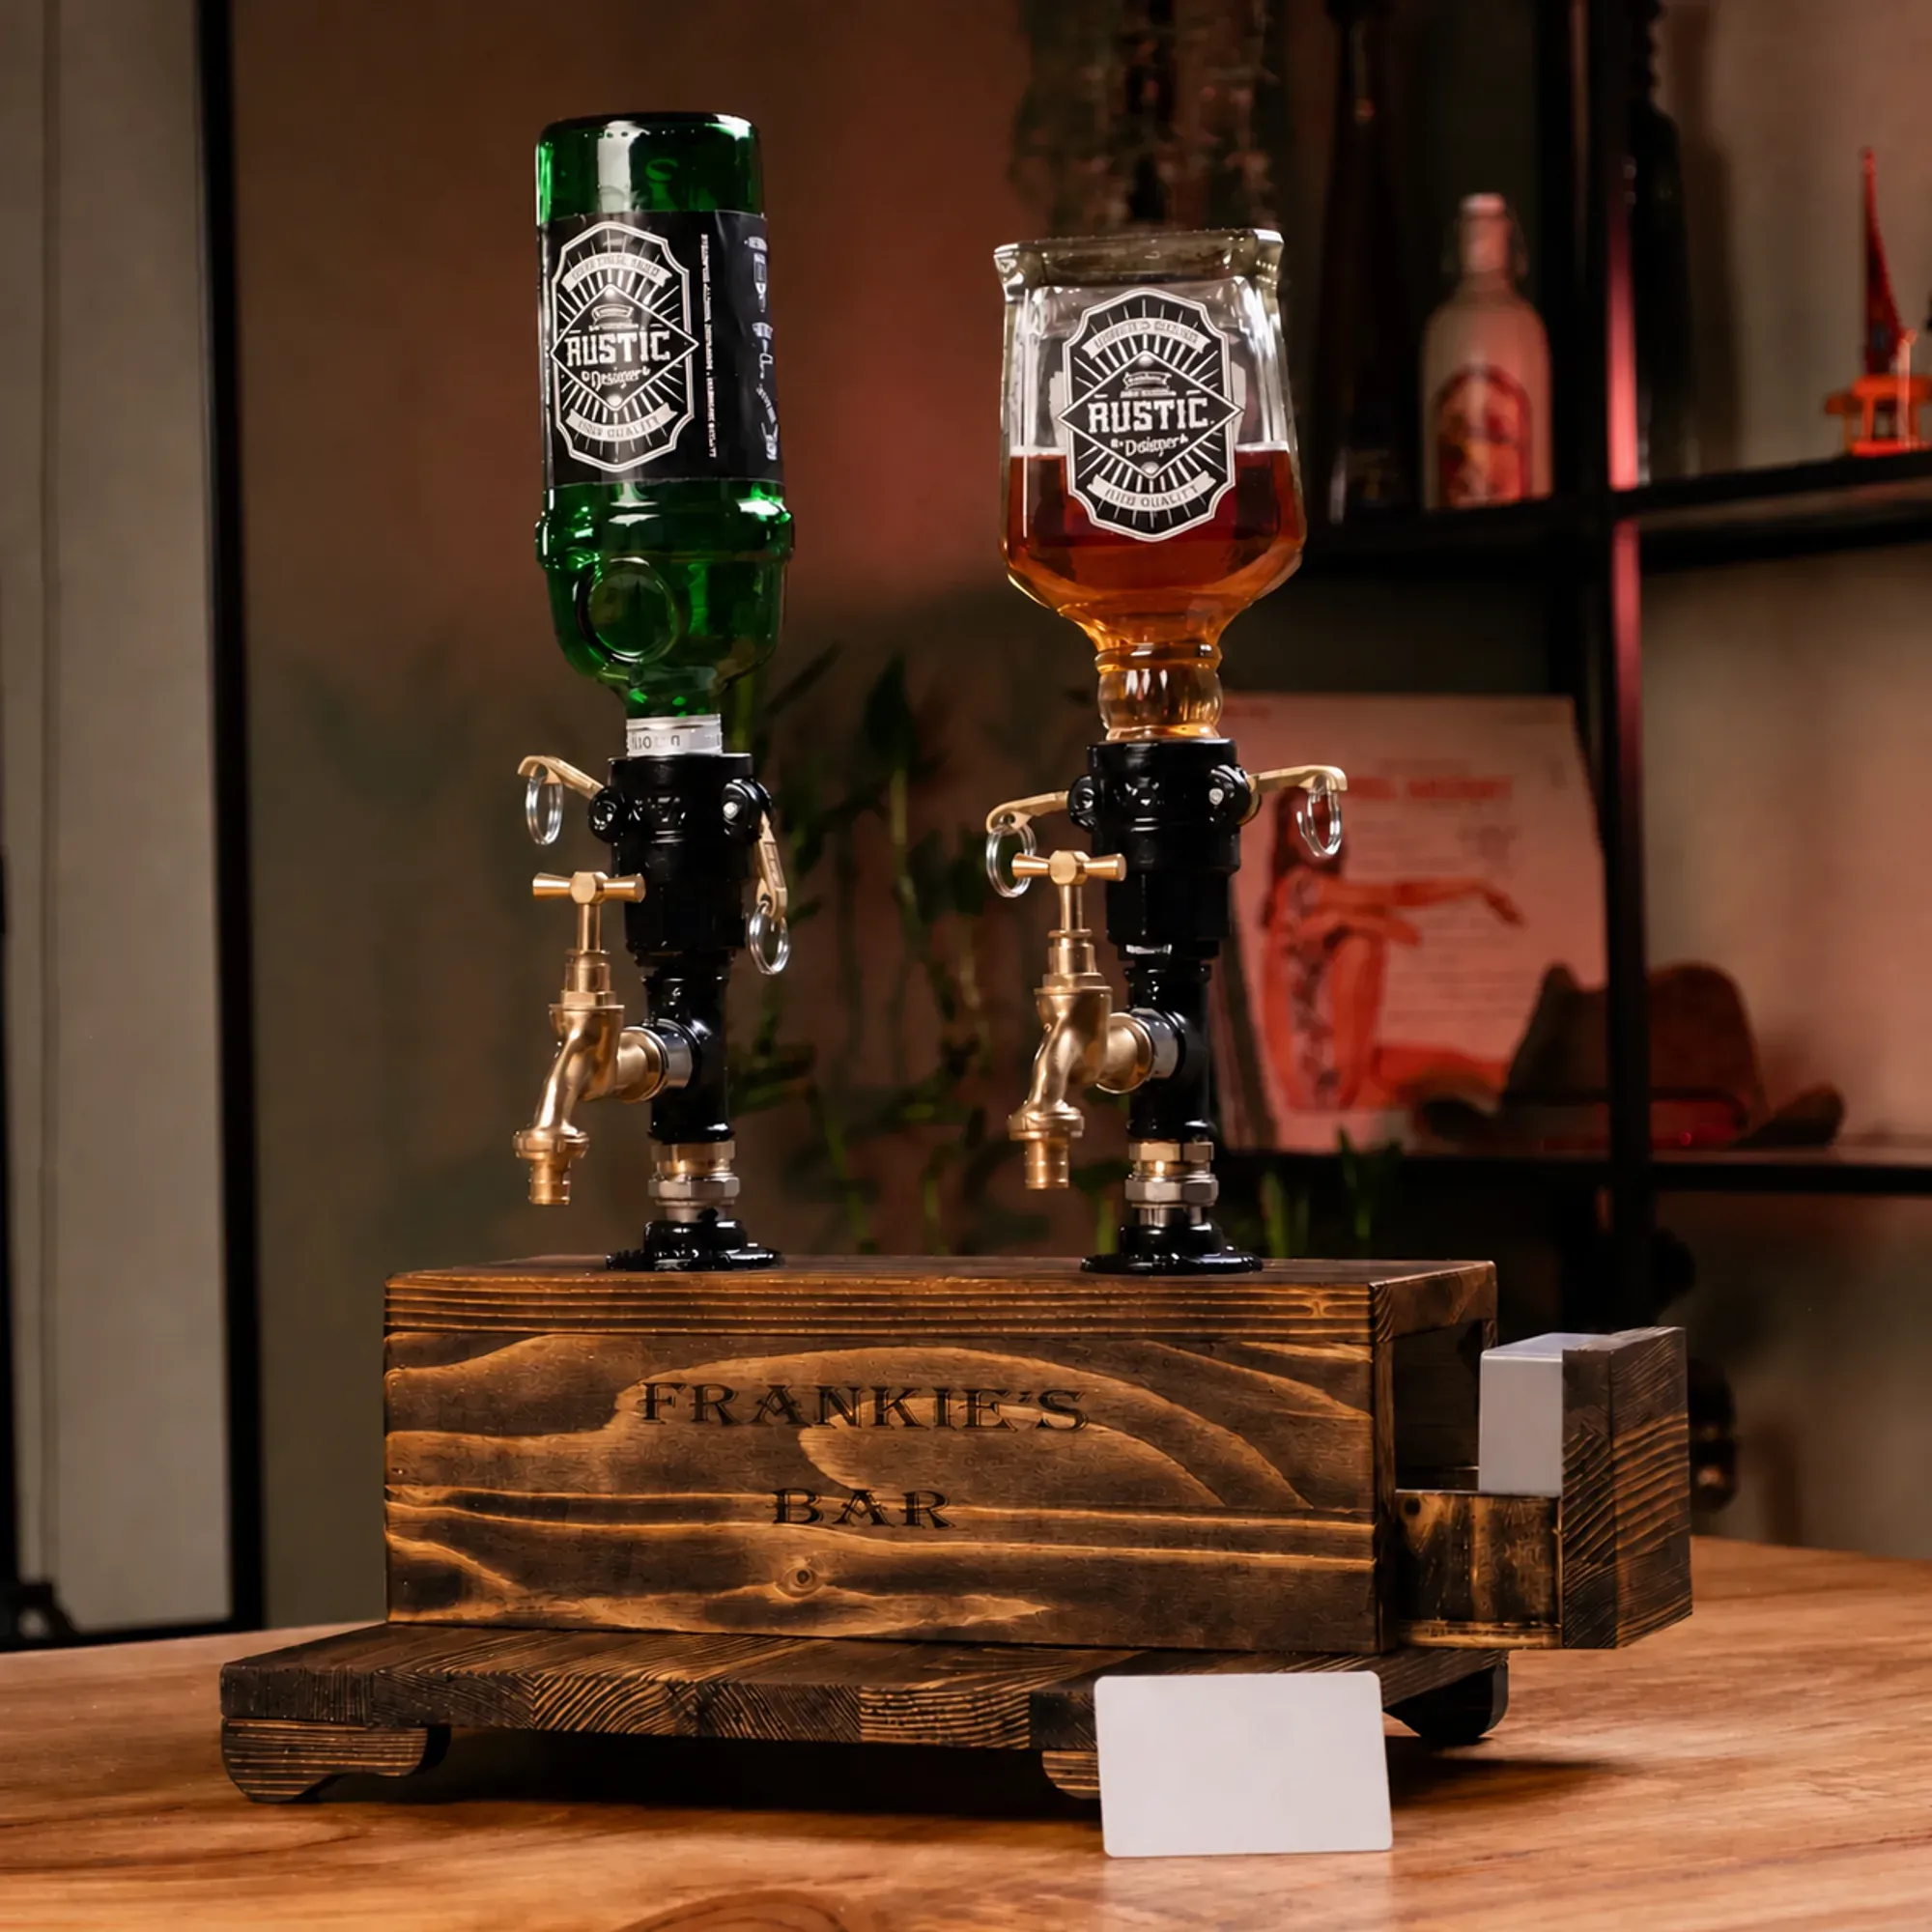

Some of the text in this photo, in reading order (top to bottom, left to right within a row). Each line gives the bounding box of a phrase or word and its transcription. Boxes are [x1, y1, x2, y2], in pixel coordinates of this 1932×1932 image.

[564, 330, 670, 367] RUSTIC
[1088, 397, 1208, 434] RUSTIC
[638, 1381, 1091, 1434] FRANKIE'S
[773, 1487, 956, 1529] BAR
